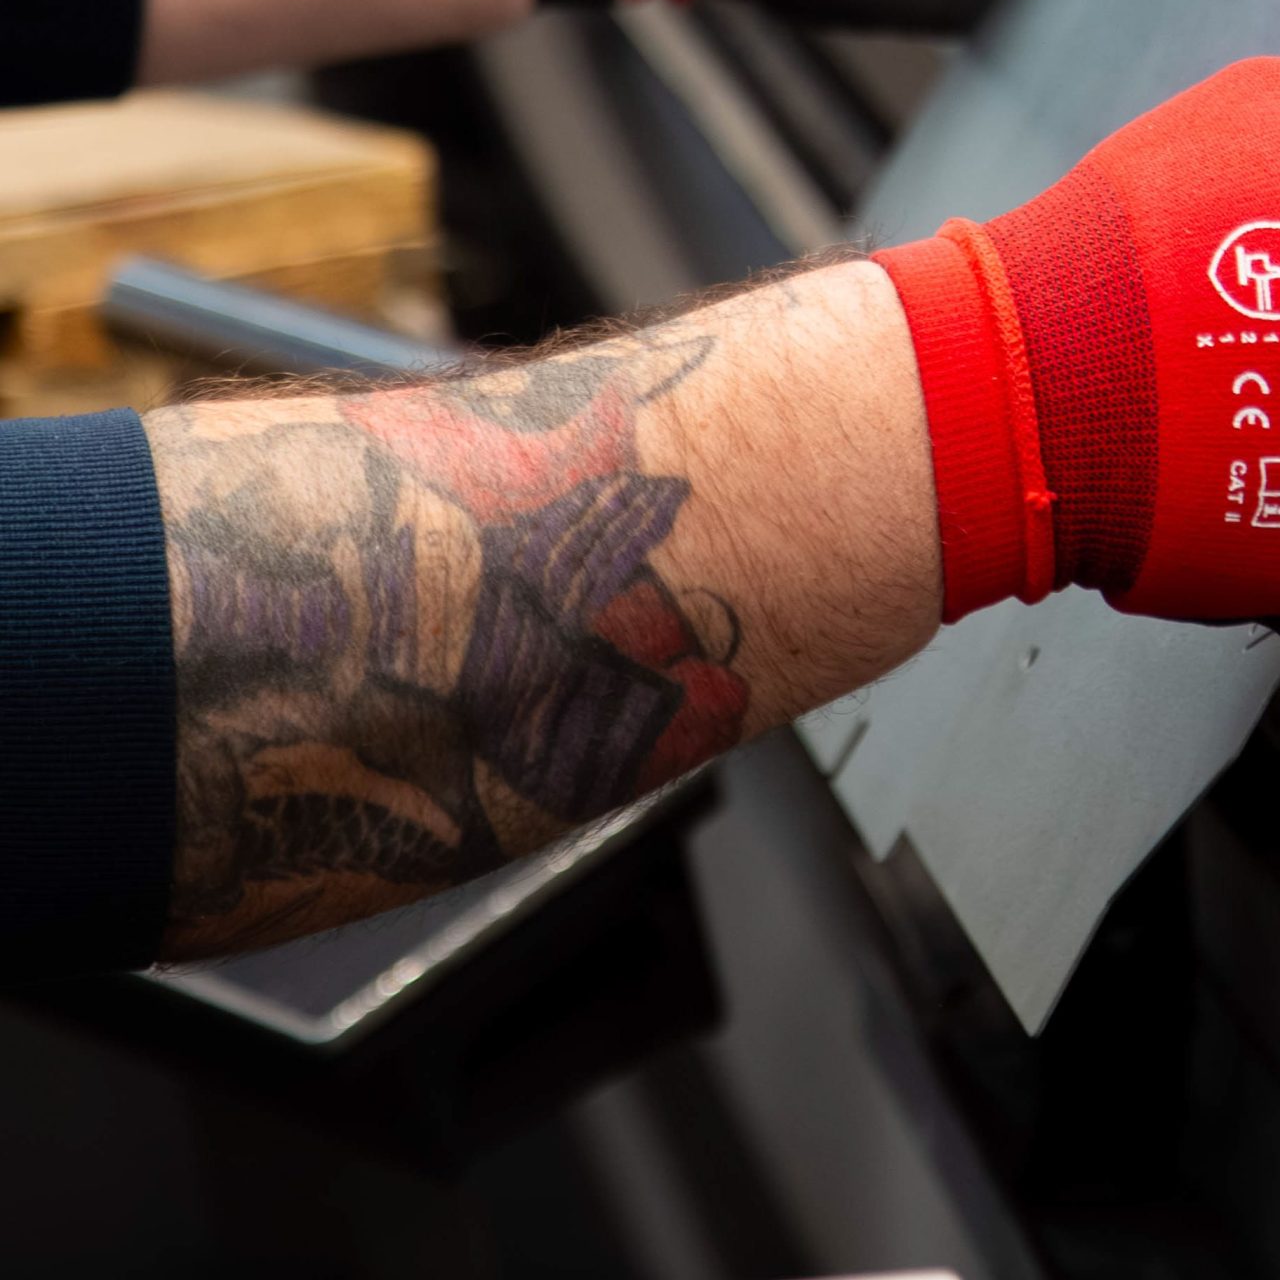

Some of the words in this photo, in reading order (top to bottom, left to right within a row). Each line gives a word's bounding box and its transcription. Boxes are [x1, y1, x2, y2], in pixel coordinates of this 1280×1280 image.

[1196, 333, 1215, 348] X
[1219, 332, 1235, 343] 1
[1240, 331, 1258, 344] 2
[1263, 332, 1280, 343] 1
[1228, 460, 1248, 504] CAT
